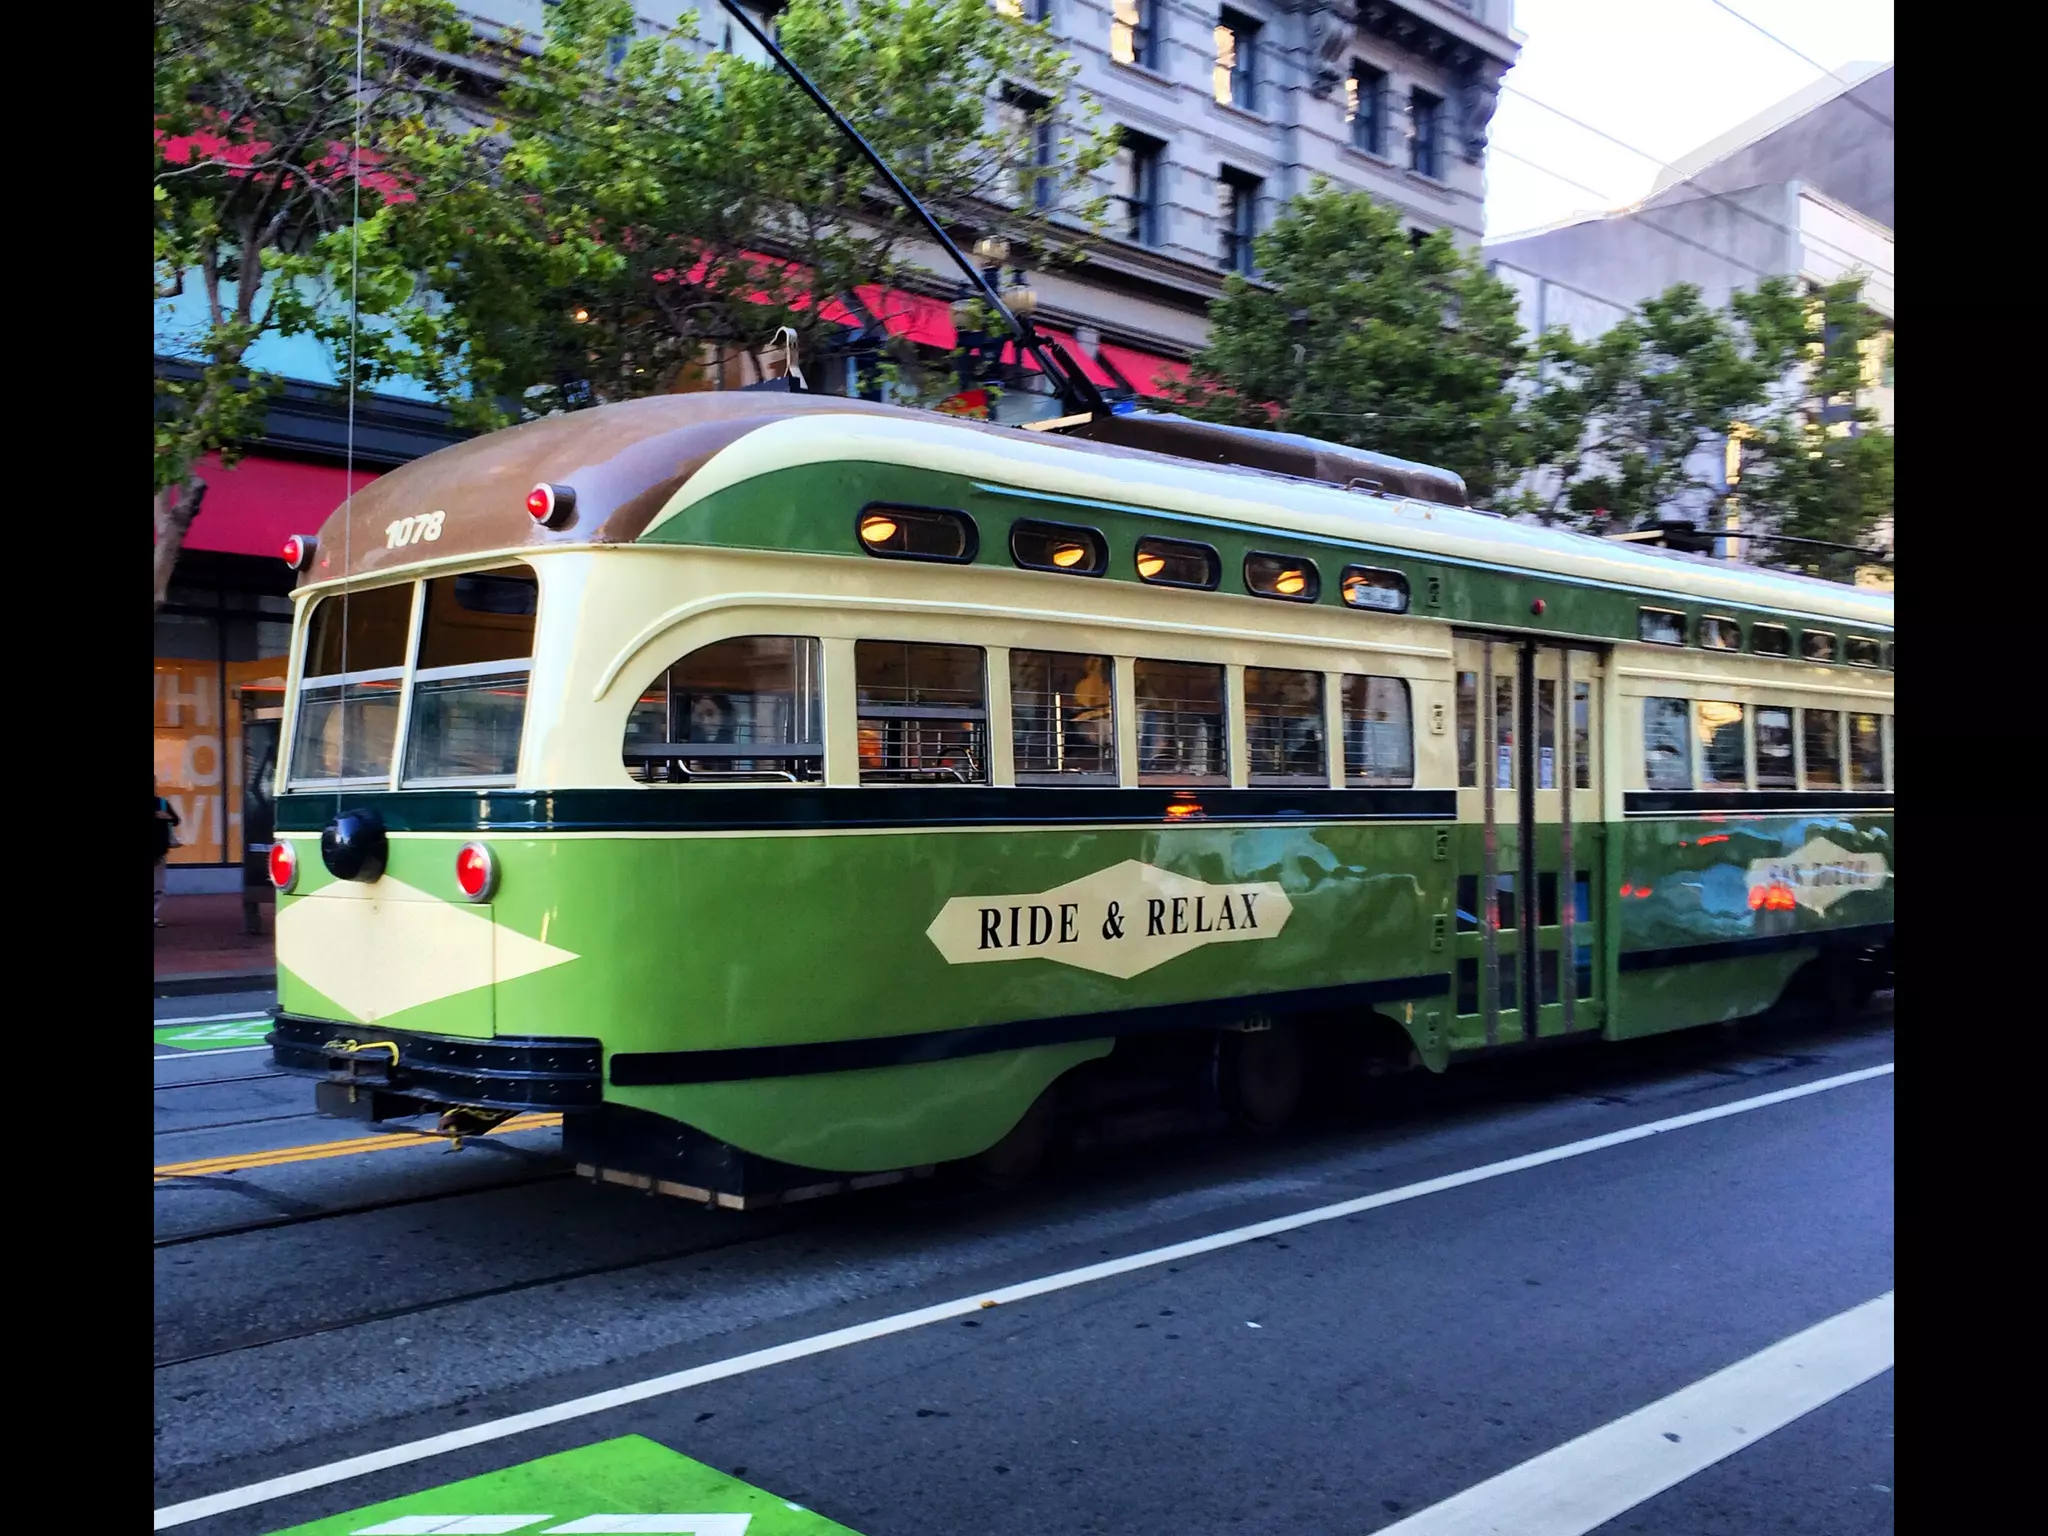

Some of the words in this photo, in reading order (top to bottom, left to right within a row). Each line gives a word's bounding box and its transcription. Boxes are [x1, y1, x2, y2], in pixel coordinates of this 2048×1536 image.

[385, 510, 446, 549] 1078
[978, 904, 1079, 950] RIDE
[1102, 901, 1125, 940] &
[1147, 893, 1259, 936] RELAX
